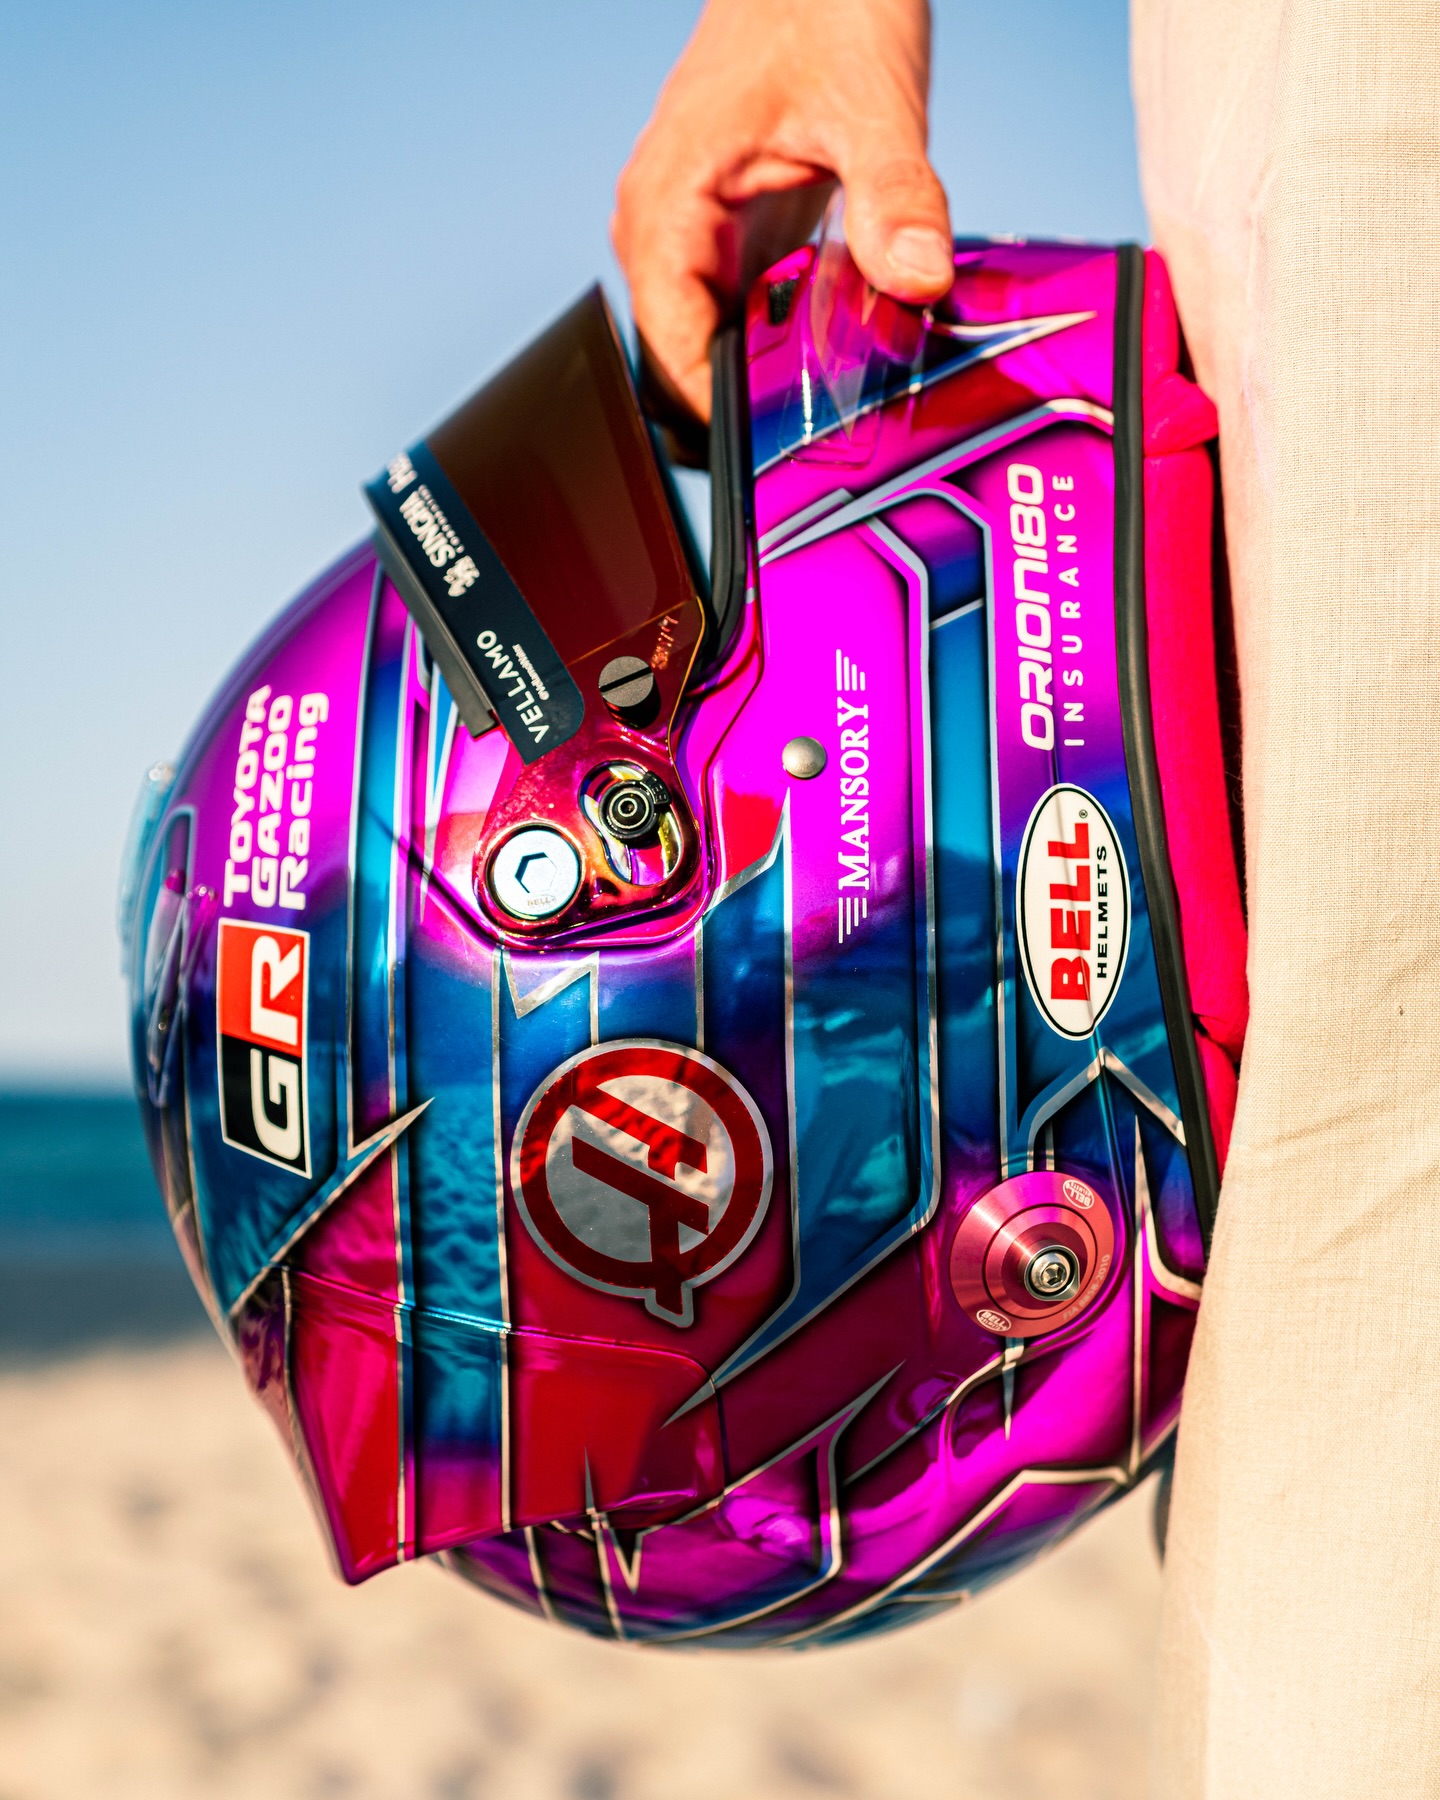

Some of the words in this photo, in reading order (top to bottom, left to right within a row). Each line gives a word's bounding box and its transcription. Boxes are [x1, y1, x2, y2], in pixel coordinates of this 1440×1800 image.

[399, 490, 456, 568] SINGHA
[1007, 462, 1055, 751] ORION180
[1052, 475, 1085, 747] INSURANCE
[476, 629, 550, 744] VELLAMO
[223, 684, 272, 908] TOYOTA
[251, 694, 293, 908] GAZOO
[279, 692, 330, 911] Racing
[837, 696, 870, 891] MANSORY
[1048, 822, 1092, 1001] BELL
[1096, 845, 1108, 979] HELMETS
[250, 935, 300, 1161] GR
[1068, 1188, 1091, 1208] BELL
[981, 1311, 1006, 1328] BELL
